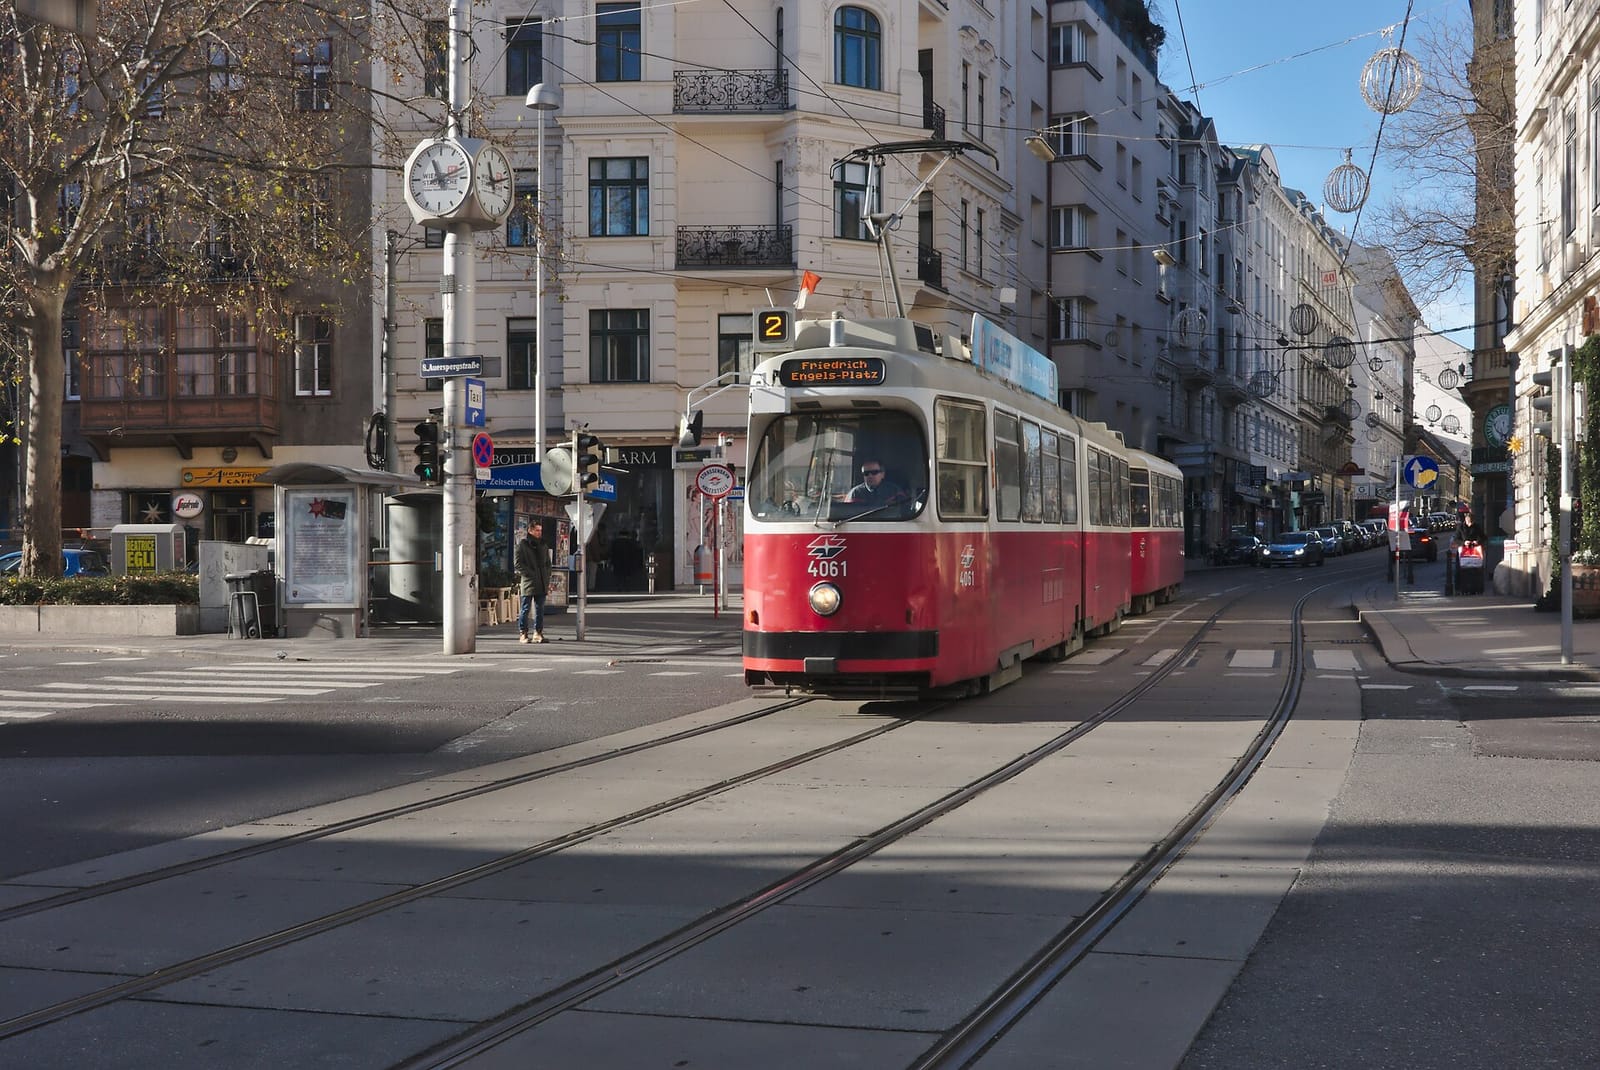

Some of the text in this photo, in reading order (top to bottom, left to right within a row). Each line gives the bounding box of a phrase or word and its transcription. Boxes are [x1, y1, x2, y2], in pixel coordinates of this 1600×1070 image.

[765, 316, 782, 336] 2
[801, 360, 868, 370] Friedrich
[791, 371, 878, 381] Engels-Platz
[492, 454, 535, 465] BOUTI
[618, 451, 657, 464] ARM
[489, 479, 535, 487] Zeitschriften
[127, 551, 155, 567] EGLI
[807, 560, 847, 577] 4061
[959, 571, 975, 586] 4061
